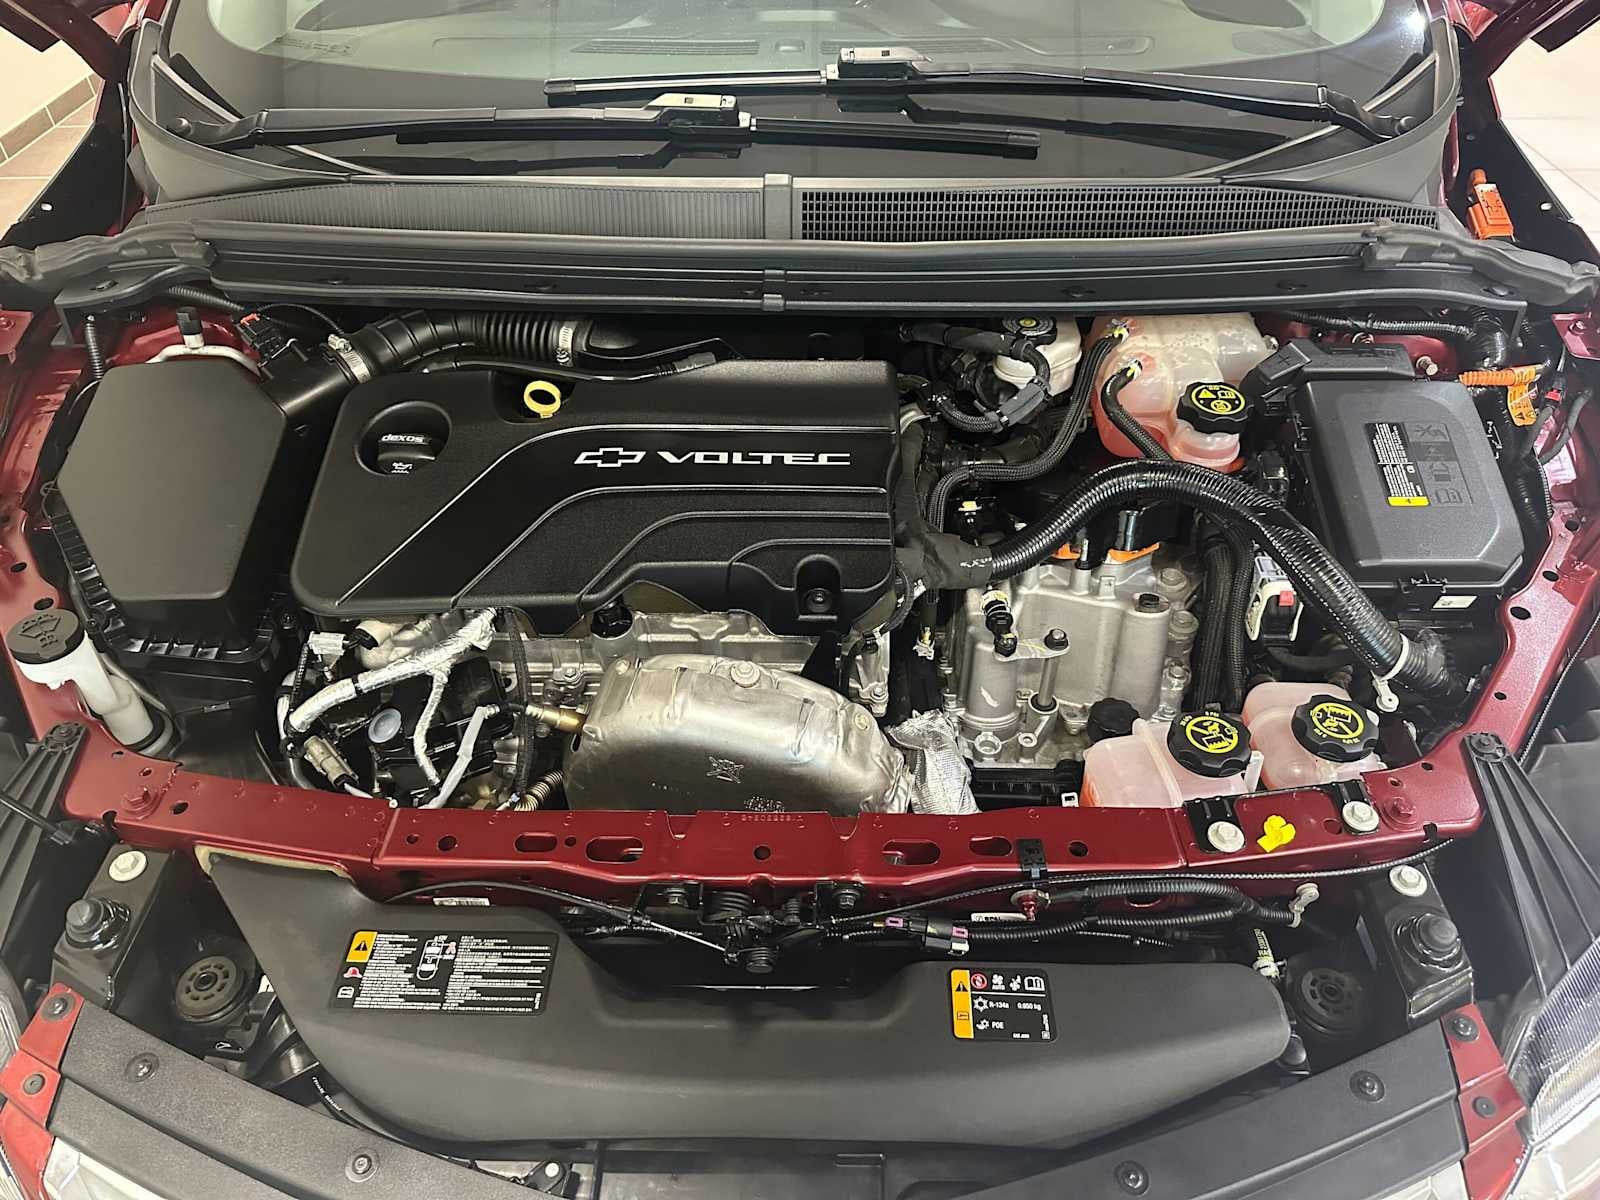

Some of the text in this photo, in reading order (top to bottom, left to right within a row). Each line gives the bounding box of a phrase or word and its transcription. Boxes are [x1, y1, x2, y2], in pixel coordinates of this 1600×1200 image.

[381, 434, 425, 443] dexos
[657, 451, 850, 465] VOLTEC
[988, 1000, 1009, 1009] R-134a
[991, 1021, 1004, 1029] POE
